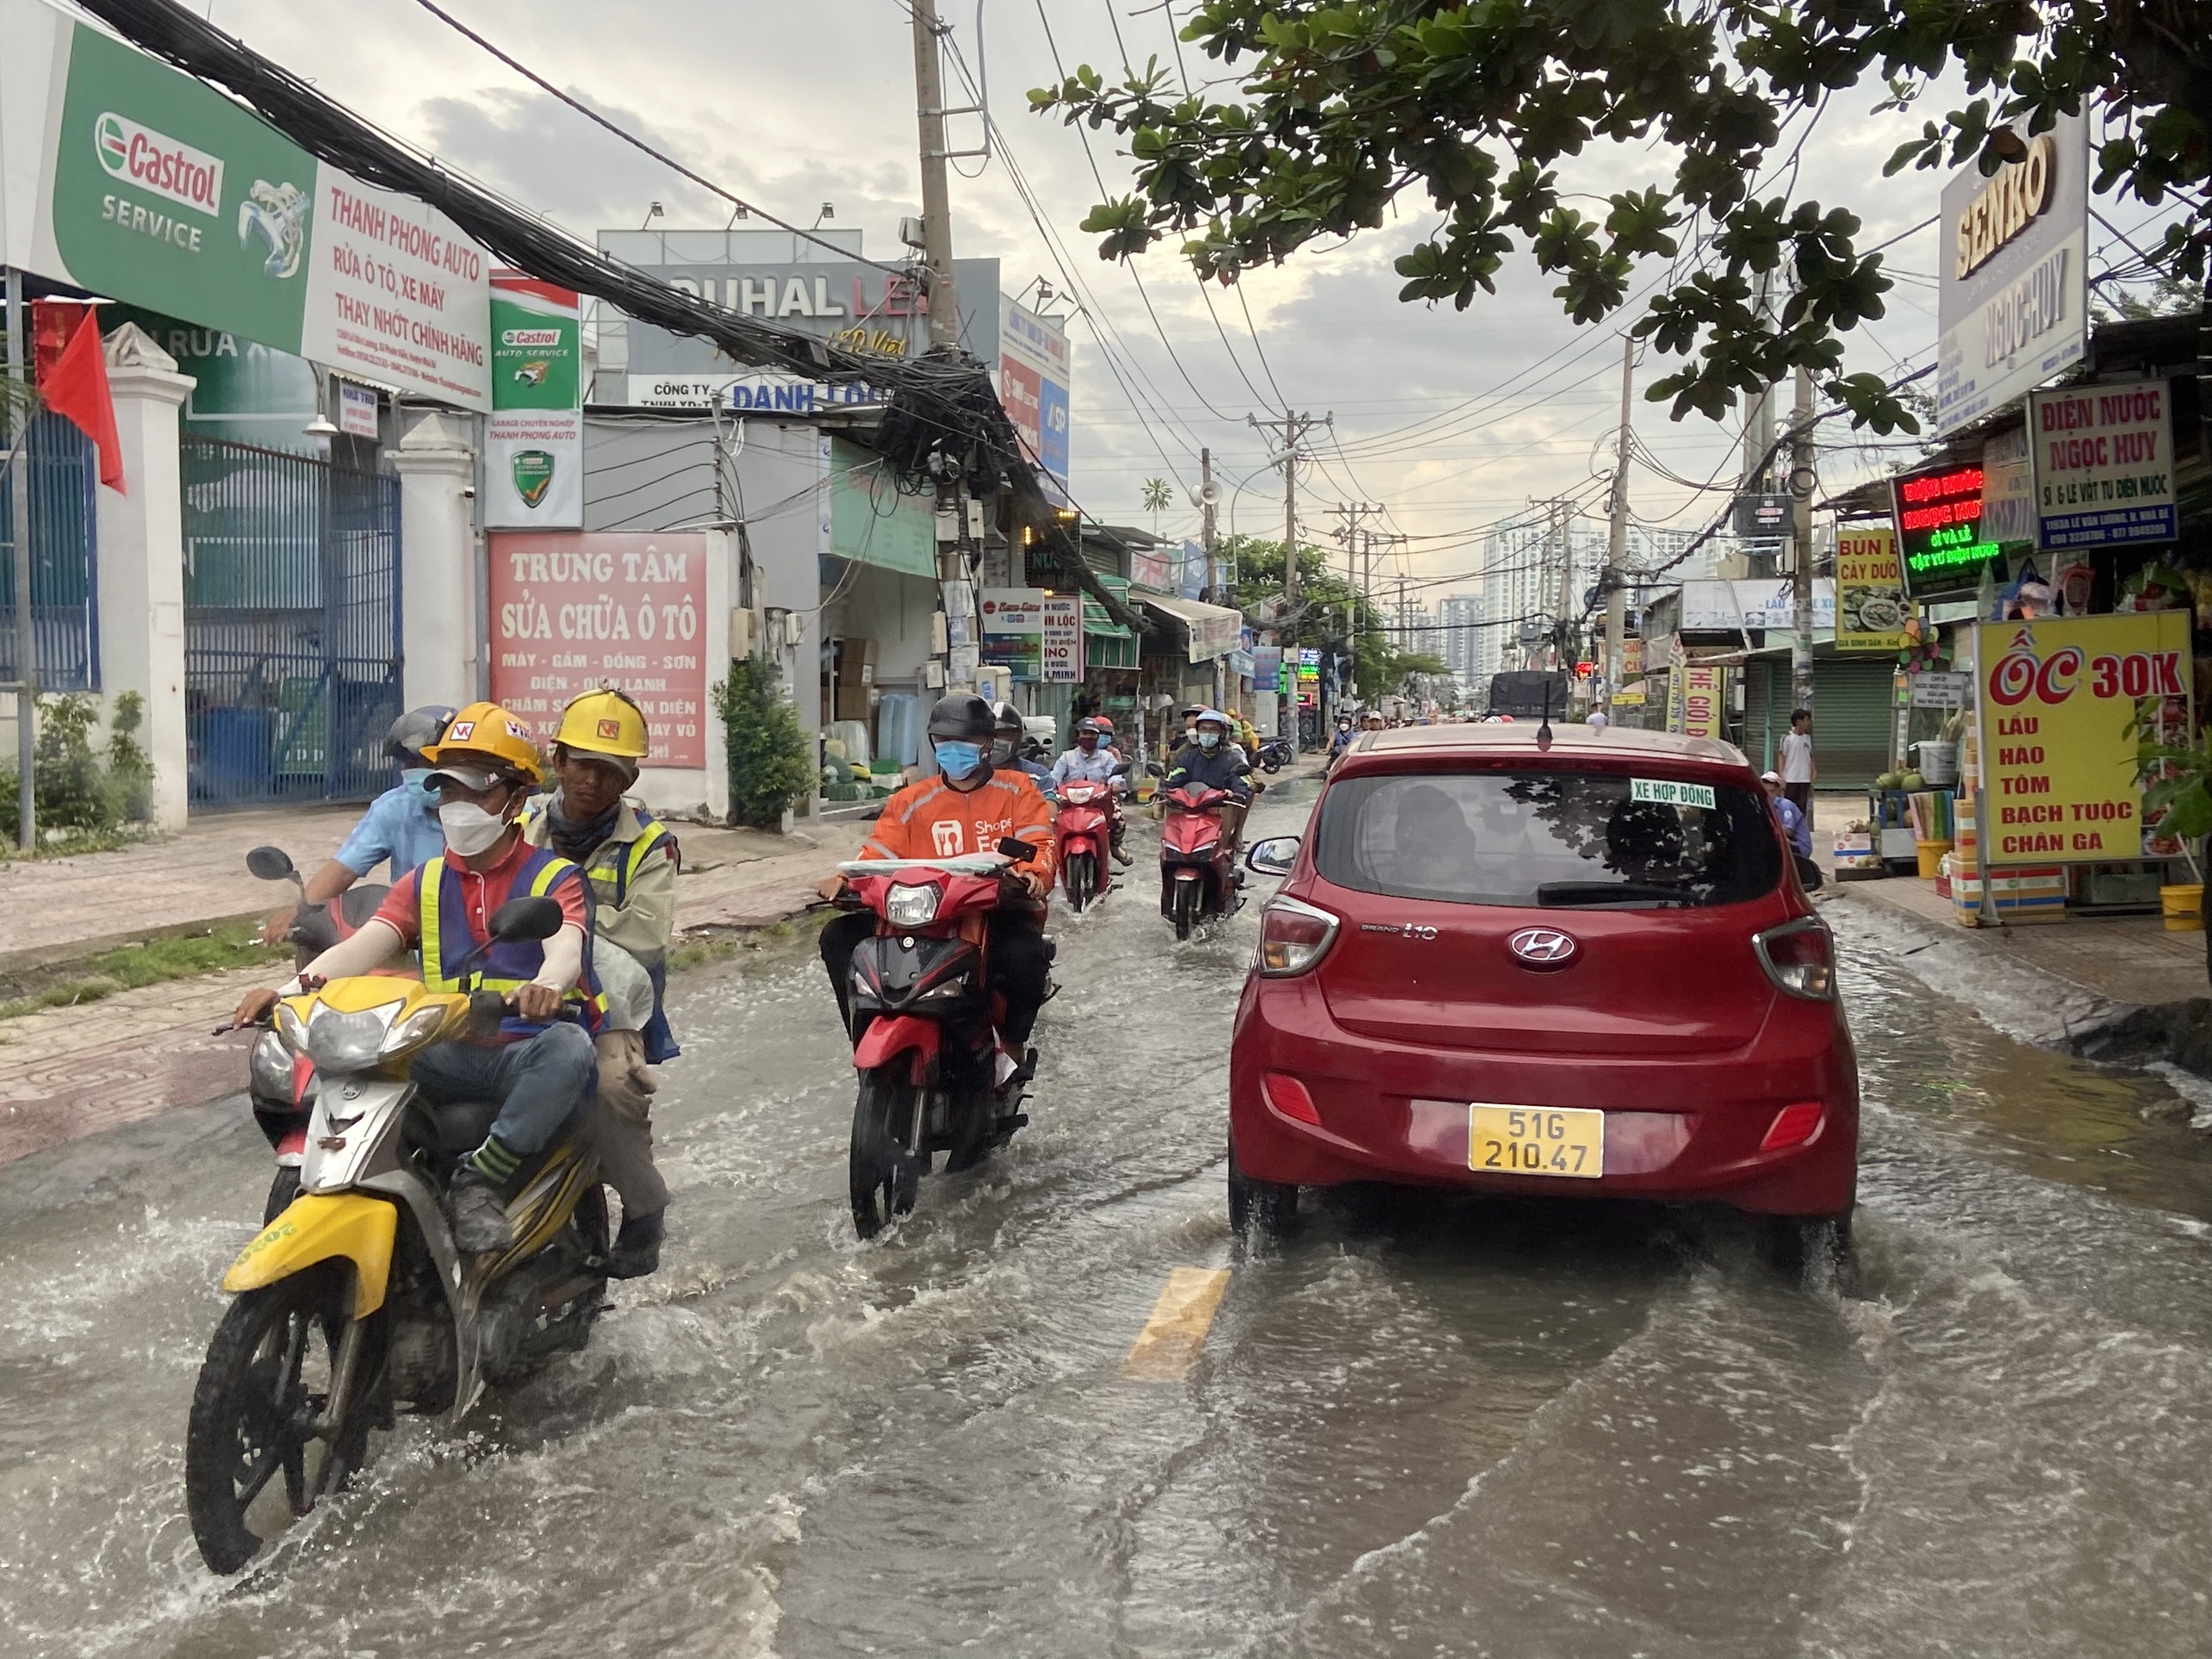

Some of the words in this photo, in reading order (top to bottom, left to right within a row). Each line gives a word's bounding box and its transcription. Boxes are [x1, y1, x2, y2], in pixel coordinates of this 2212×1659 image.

[129, 133, 215, 208] Castrol
[1955, 134, 2055, 281] SENKO
[102, 195, 202, 252] SERVICE
[331, 186, 386, 242] THANH
[388, 214, 441, 266] PHONG
[443, 241, 480, 283] AUTO
[333, 242, 362, 280] RỬA
[364, 253, 376, 284] Ô
[401, 273, 417, 301] XE
[419, 281, 444, 312] MÁY
[335, 291, 370, 327] THAY
[374, 309, 409, 341] NHỚT
[412, 320, 449, 355] CHÍNH
[450, 333, 483, 367] HÀNG
[516, 332, 556, 344] Castrol
[654, 383, 689, 395] CÔNG
[734, 385, 814, 411] DANH
[2041, 395, 2094, 432] ĐIỆN
[2098, 387, 2161, 426] NƯỚC
[489, 432, 519, 440] THANH
[520, 432, 551, 440] PHONG
[552, 431, 576, 440] AUTO
[2114, 431, 2157, 465] HUY
[1839, 535, 1881, 556] BÚN
[510, 552, 613, 583] TRUNG
[622, 544, 687, 583] TÂM
[501, 588, 552, 639] SỬA
[559, 593, 631, 640] CHỮA
[637, 593, 656, 640] Ô
[662, 593, 697, 640] TÔ
[502, 649, 536, 667] MÁY
[663, 655, 696, 668] SƠN
[1988, 626, 2086, 706] ỐC
[2091, 651, 2184, 699] 30K
[531, 675, 568, 693] ĐIỆN
[625, 678, 667, 693] LẠNH
[660, 700, 696, 717] ĐIỆN
[677, 721, 696, 736] VỎ
[1998, 711, 2038, 736] LẨU
[1635, 781, 1650, 798] XE
[1681, 784, 1712, 806] ĐỒNG
[2001, 774, 2050, 794] TÔM
[975, 817, 1012, 835] Shope
[2001, 805, 2063, 827] BẠCH
[2072, 800, 2132, 823] TUỘC
[2003, 832, 2064, 853] CHÂN
[2072, 830, 2103, 850] GÀ
[1402, 922, 1438, 941] i10
[1509, 1112, 1565, 1140] 51G
[1485, 1140, 1588, 1171] 210.47
